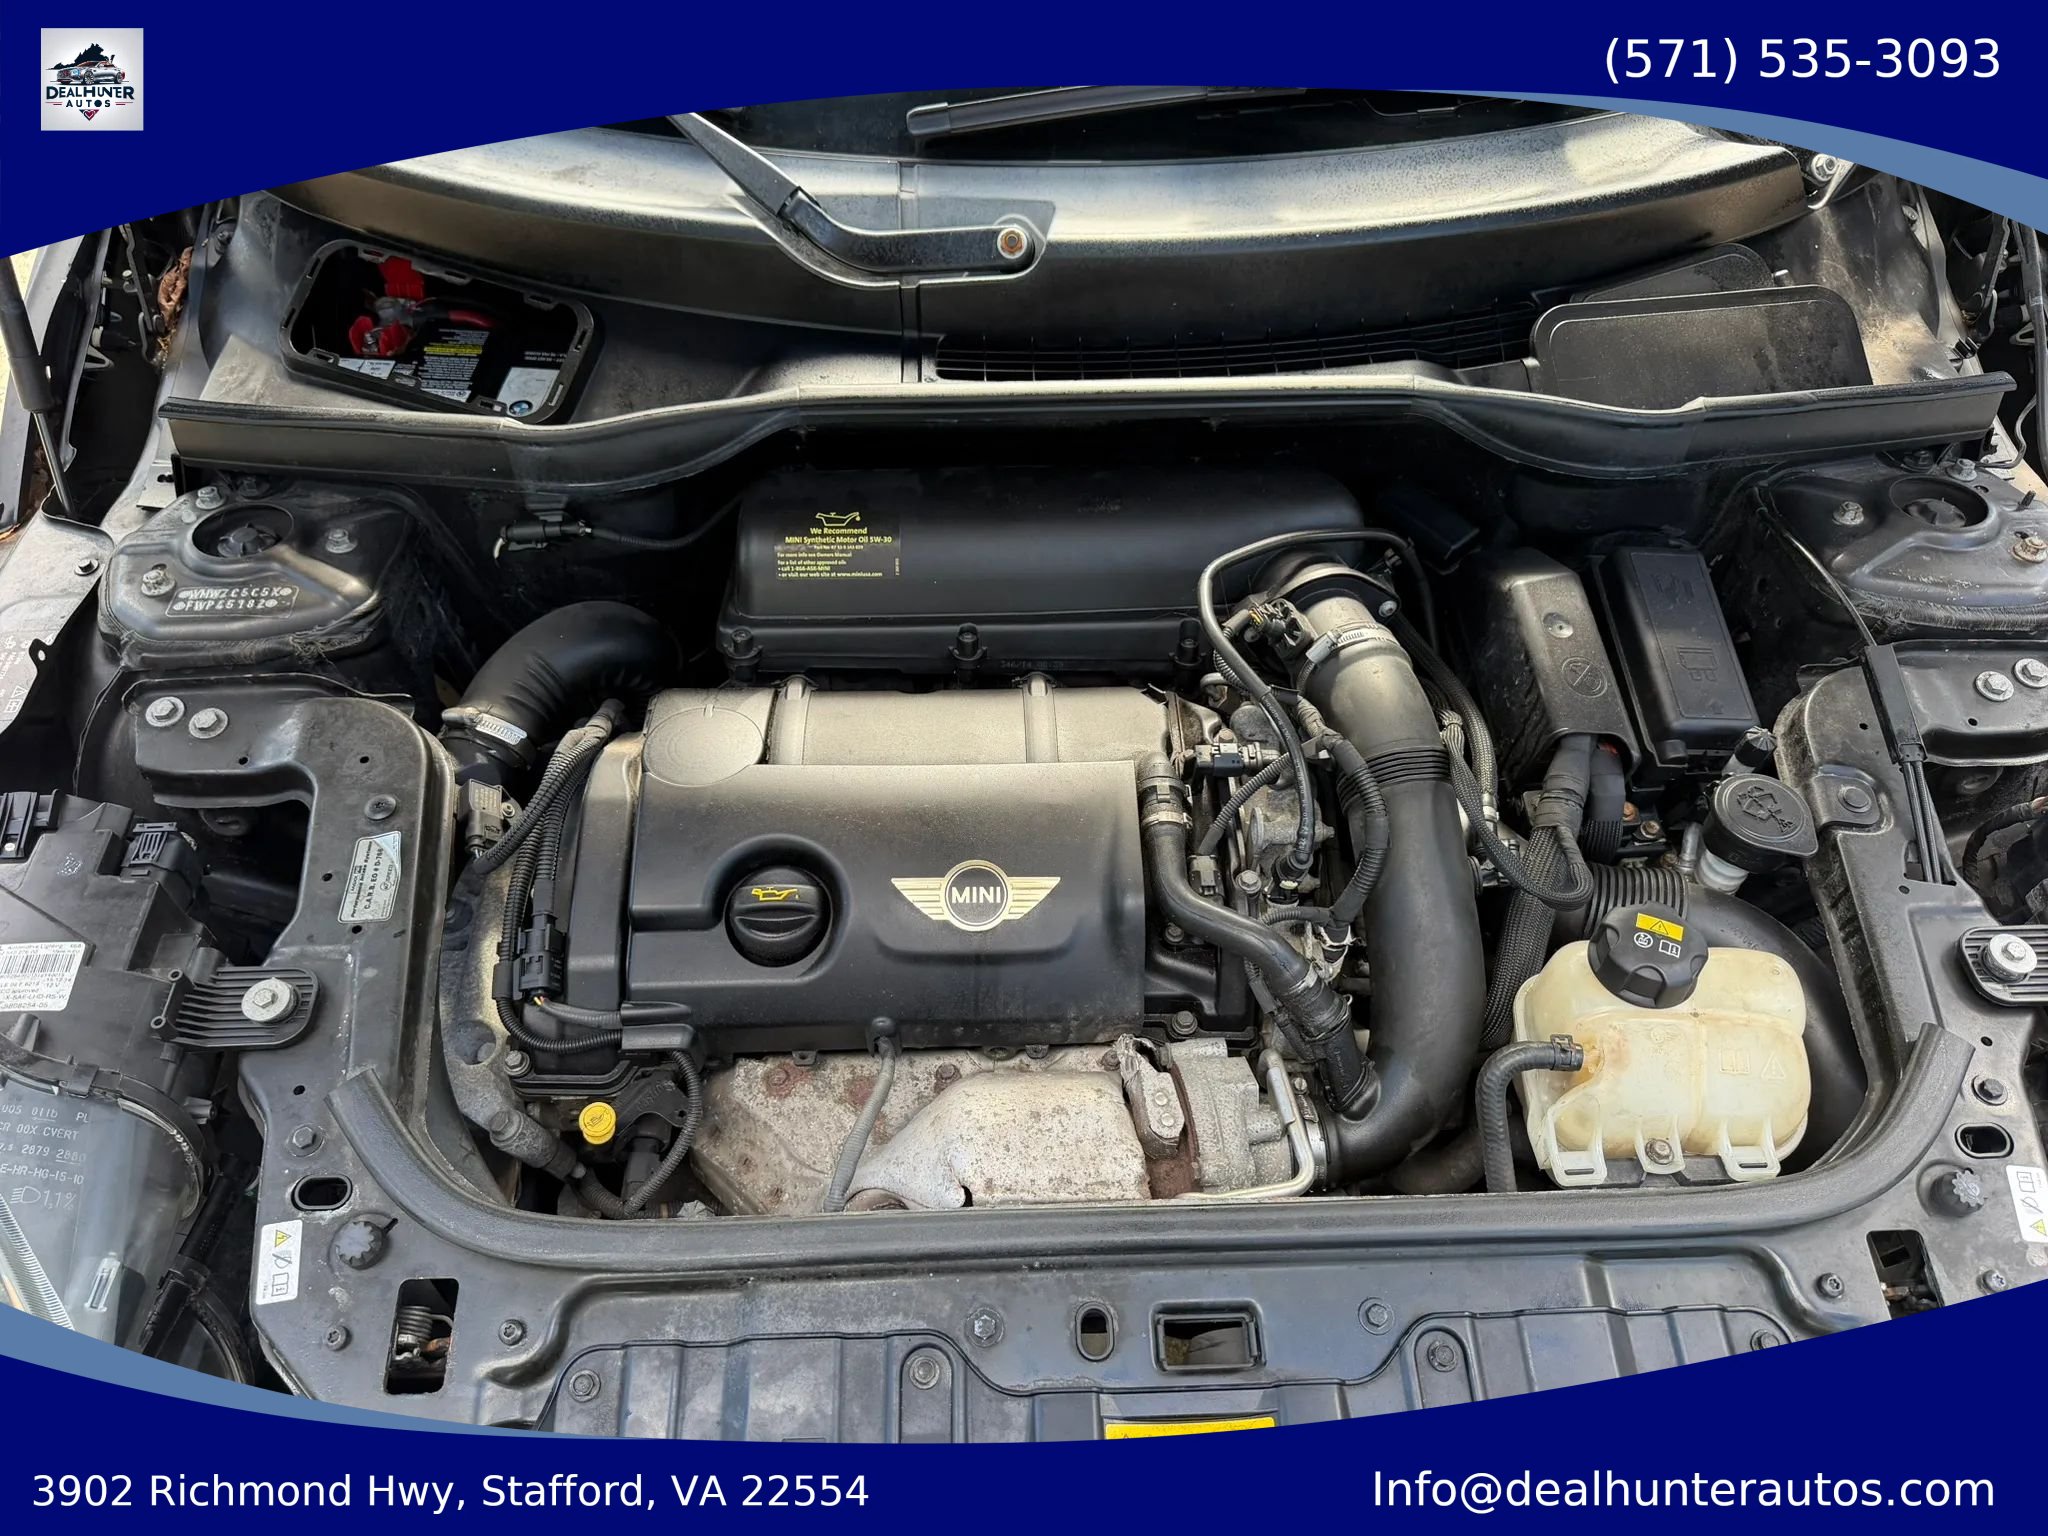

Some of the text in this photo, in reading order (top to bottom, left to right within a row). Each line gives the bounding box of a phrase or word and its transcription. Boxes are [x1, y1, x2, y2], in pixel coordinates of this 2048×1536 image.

[804, 536, 835, 545] Synthetic
[952, 886, 1001, 904] MINI
[43, 1126, 80, 1140] CVERT
[21, 1144, 50, 1156] 2879
